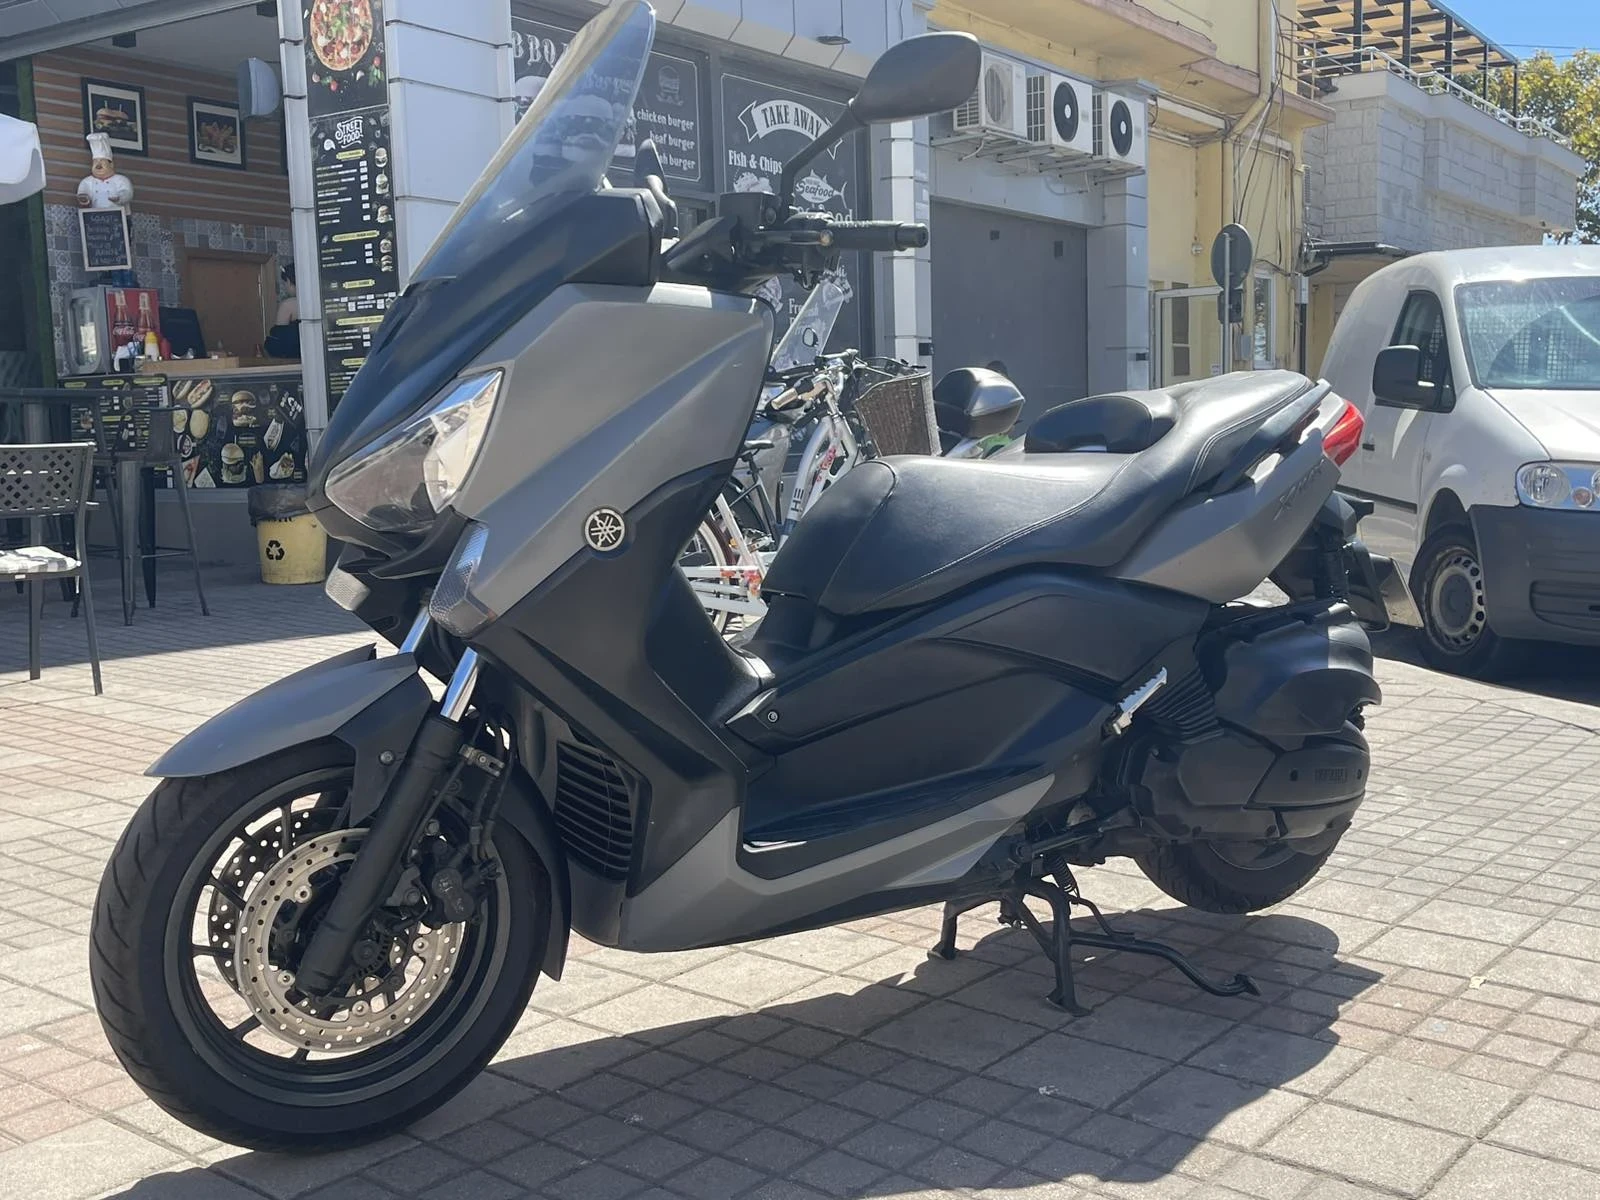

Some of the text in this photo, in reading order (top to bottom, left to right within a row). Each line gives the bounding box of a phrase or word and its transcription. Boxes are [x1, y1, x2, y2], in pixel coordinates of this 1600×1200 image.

[335, 119, 363, 140] STREET
[637, 109, 694, 131] chicken burger
[761, 104, 823, 139] TAKE AWAY
[342, 130, 362, 145] FOOD
[669, 134, 695, 151] burger
[669, 153, 695, 171] burger
[728, 149, 783, 175] Fish & Chips
